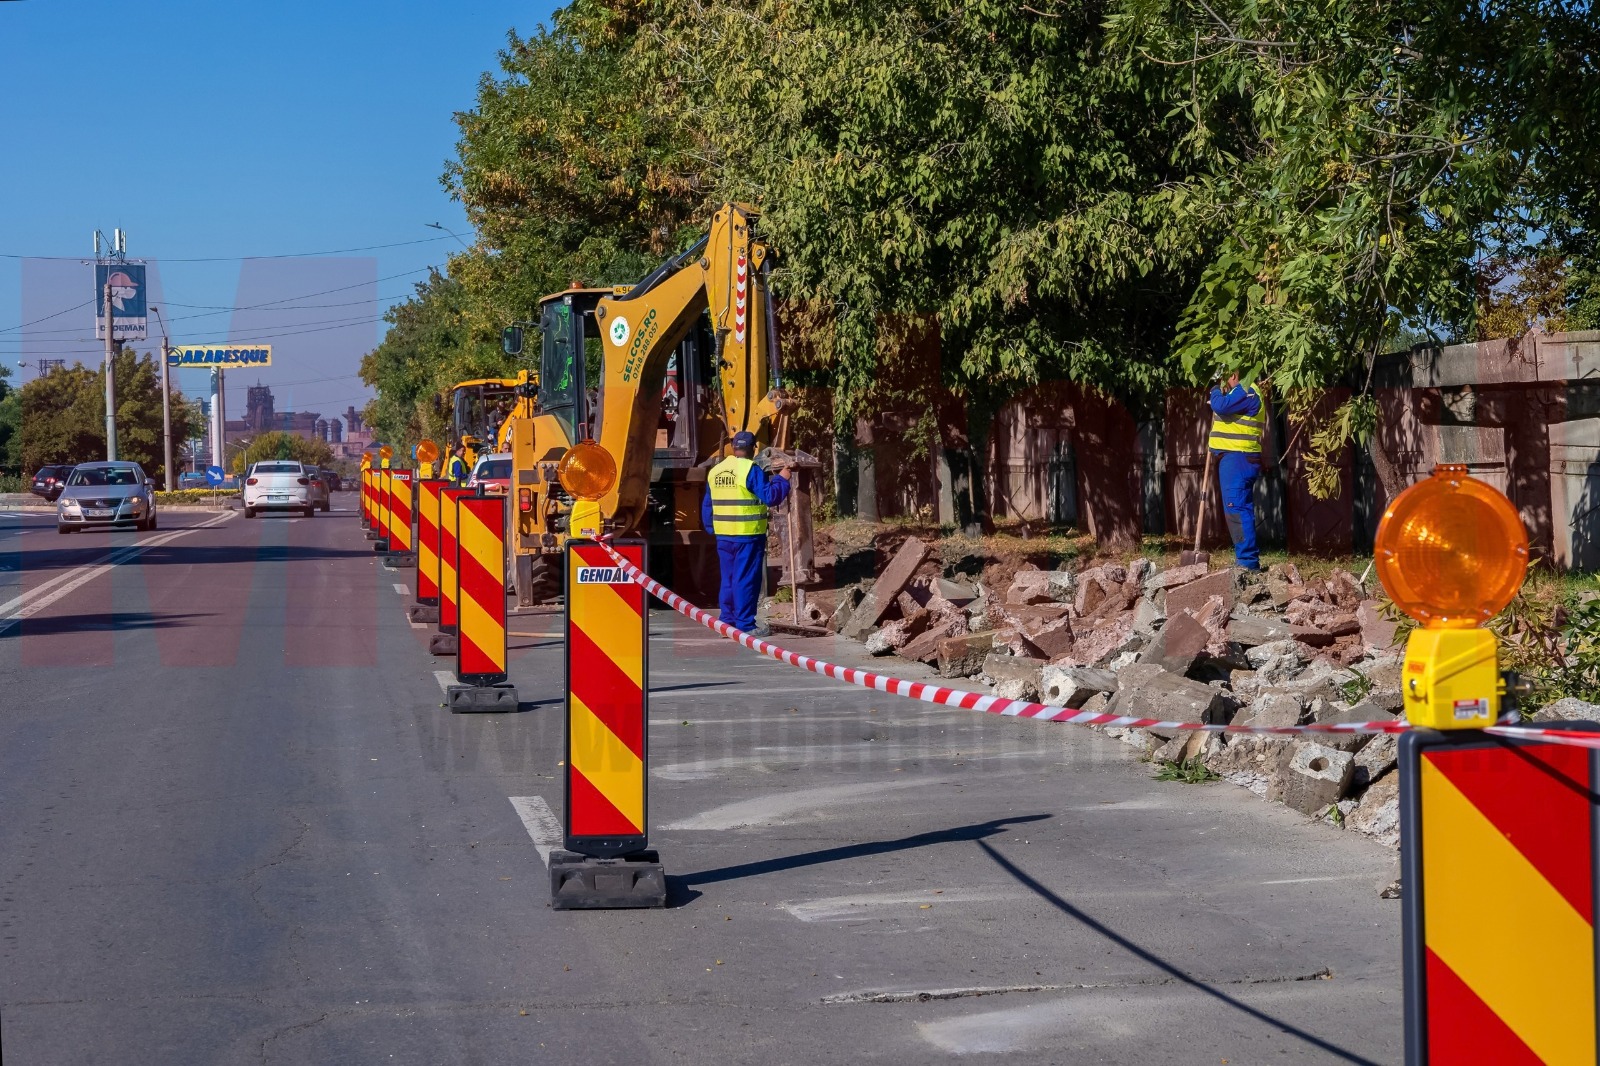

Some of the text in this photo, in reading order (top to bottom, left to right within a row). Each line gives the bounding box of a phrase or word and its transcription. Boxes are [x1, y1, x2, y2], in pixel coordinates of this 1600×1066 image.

[100, 324, 145, 332] DDEMAN
[624, 308, 656, 383] SELCOS.RO
[183, 350, 269, 364] ARABESQUE
[632, 321, 659, 380] 0748.288.057
